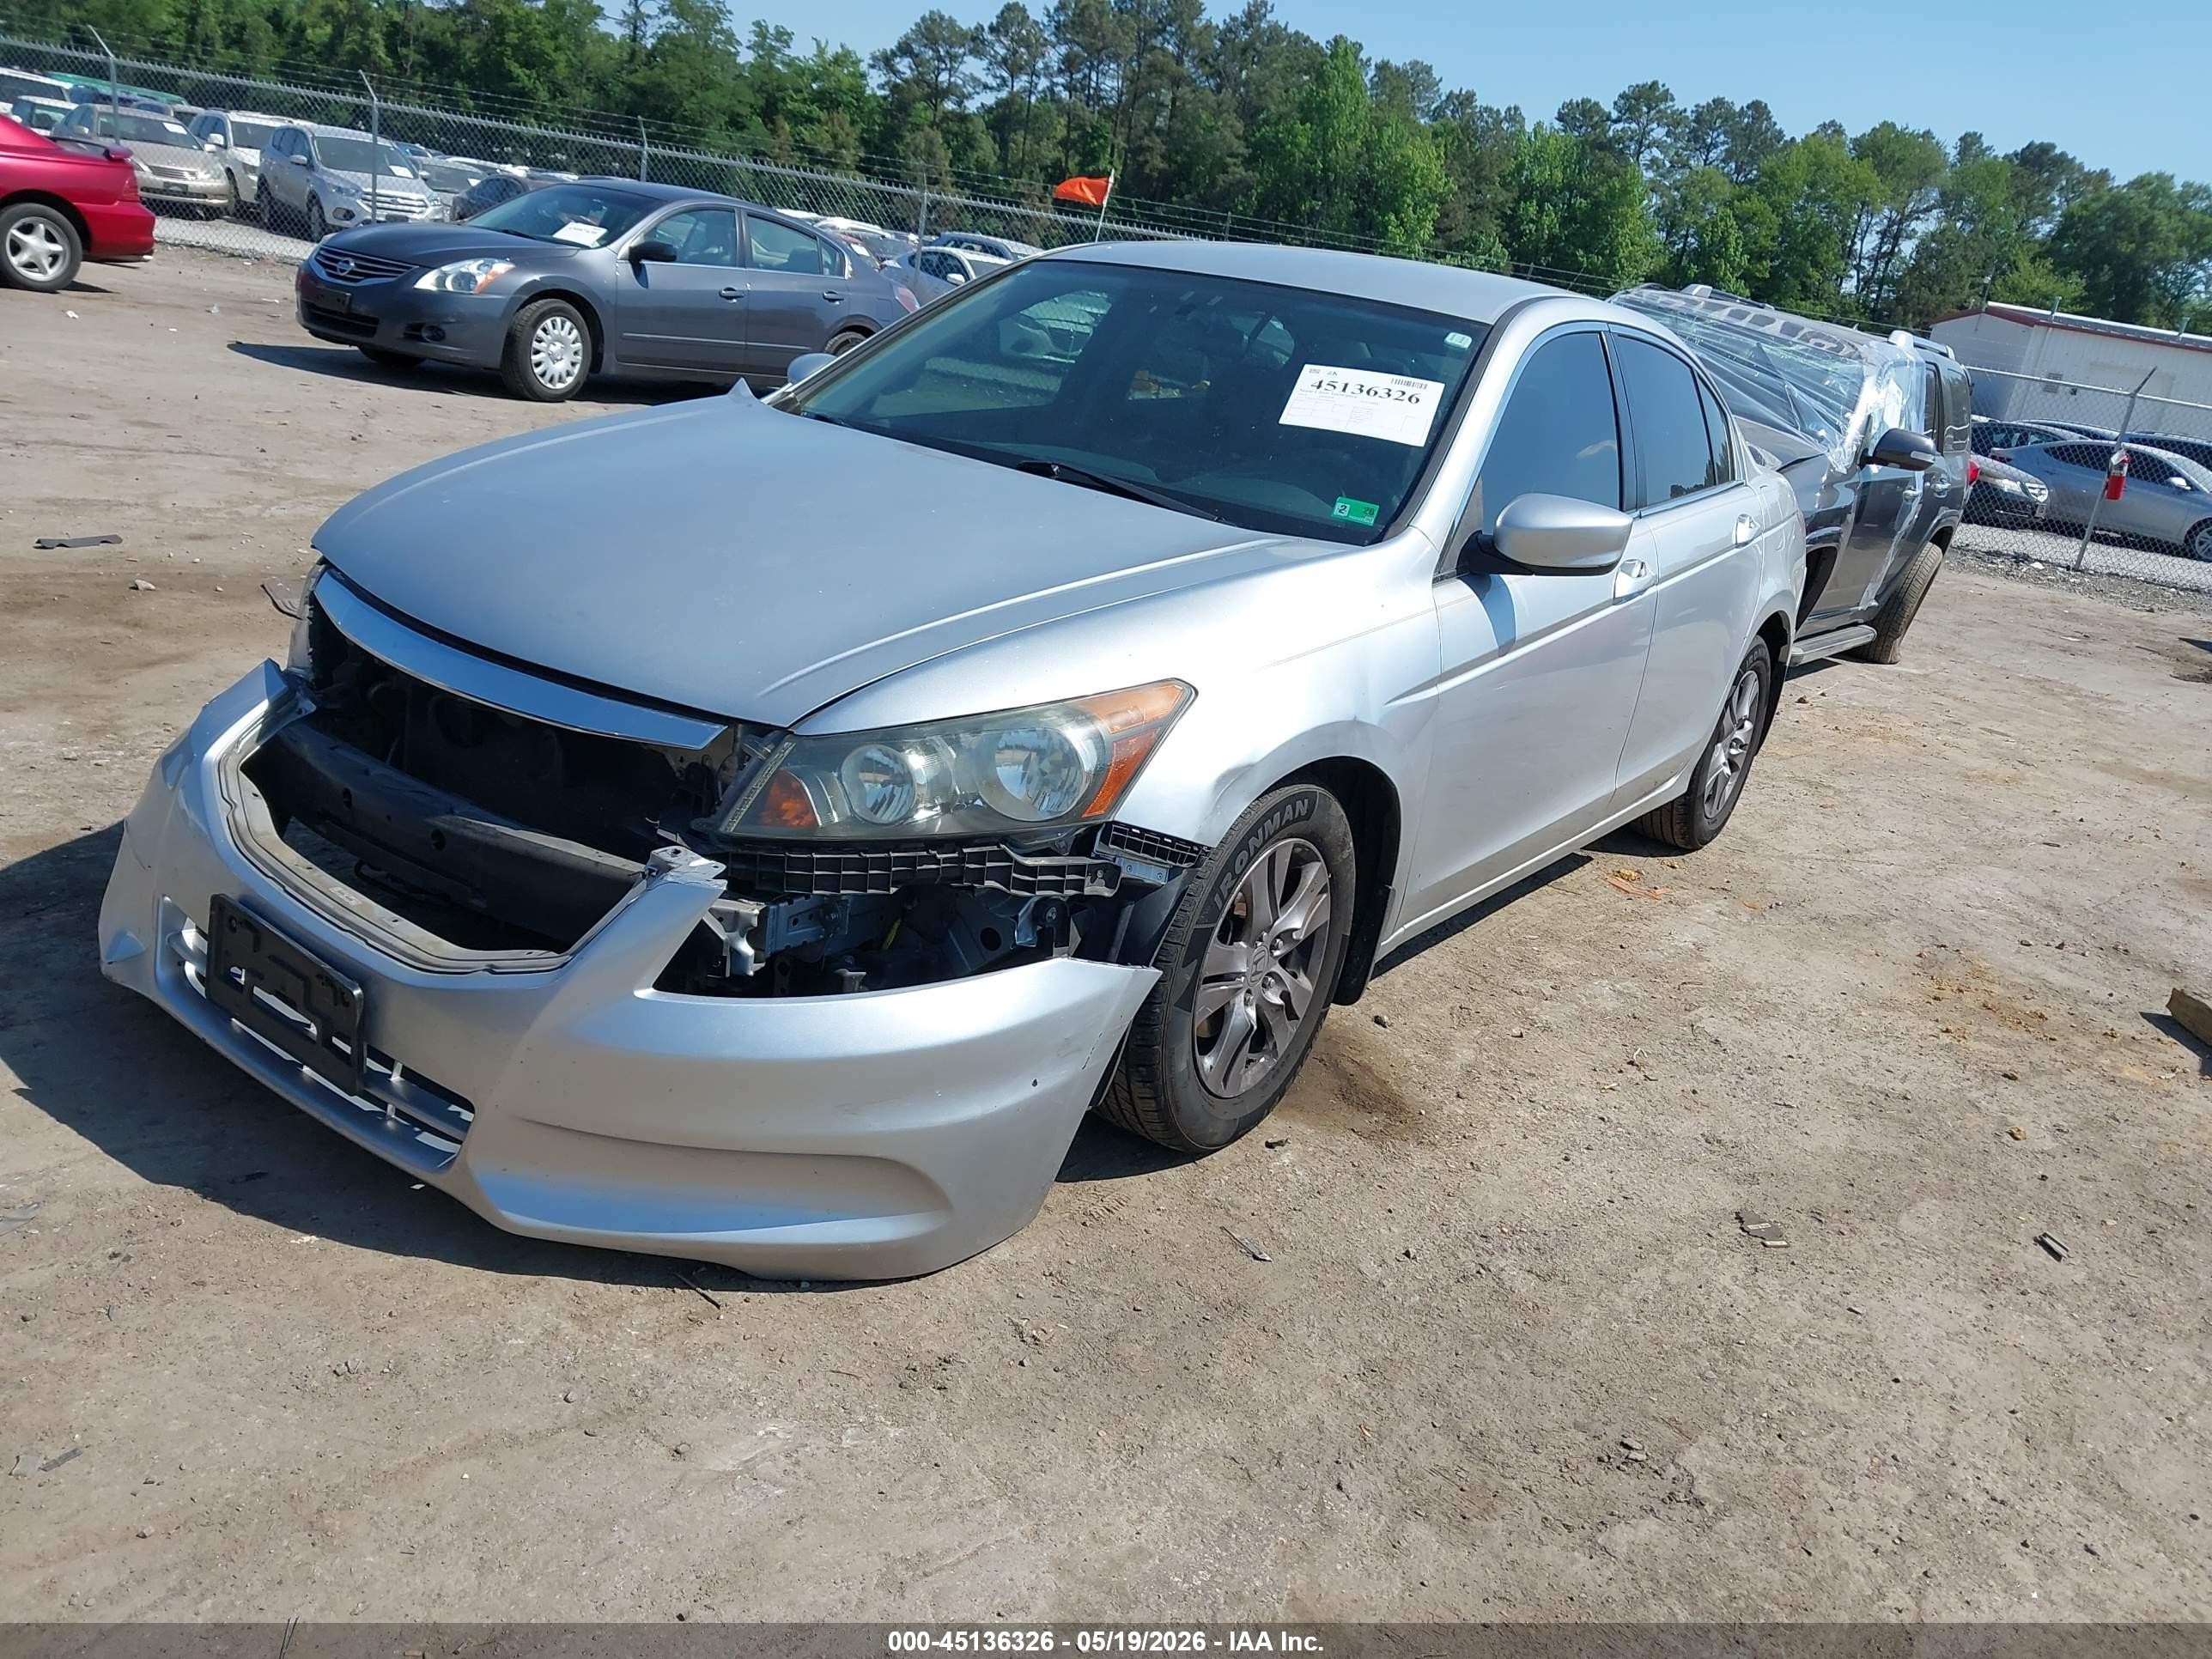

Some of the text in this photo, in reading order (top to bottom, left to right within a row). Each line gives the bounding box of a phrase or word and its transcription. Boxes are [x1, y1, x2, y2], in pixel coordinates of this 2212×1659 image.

[1310, 380, 1422, 404] 45136326
[1338, 505, 1347, 514] 2
[1214, 799, 1309, 910] IRONMAN
